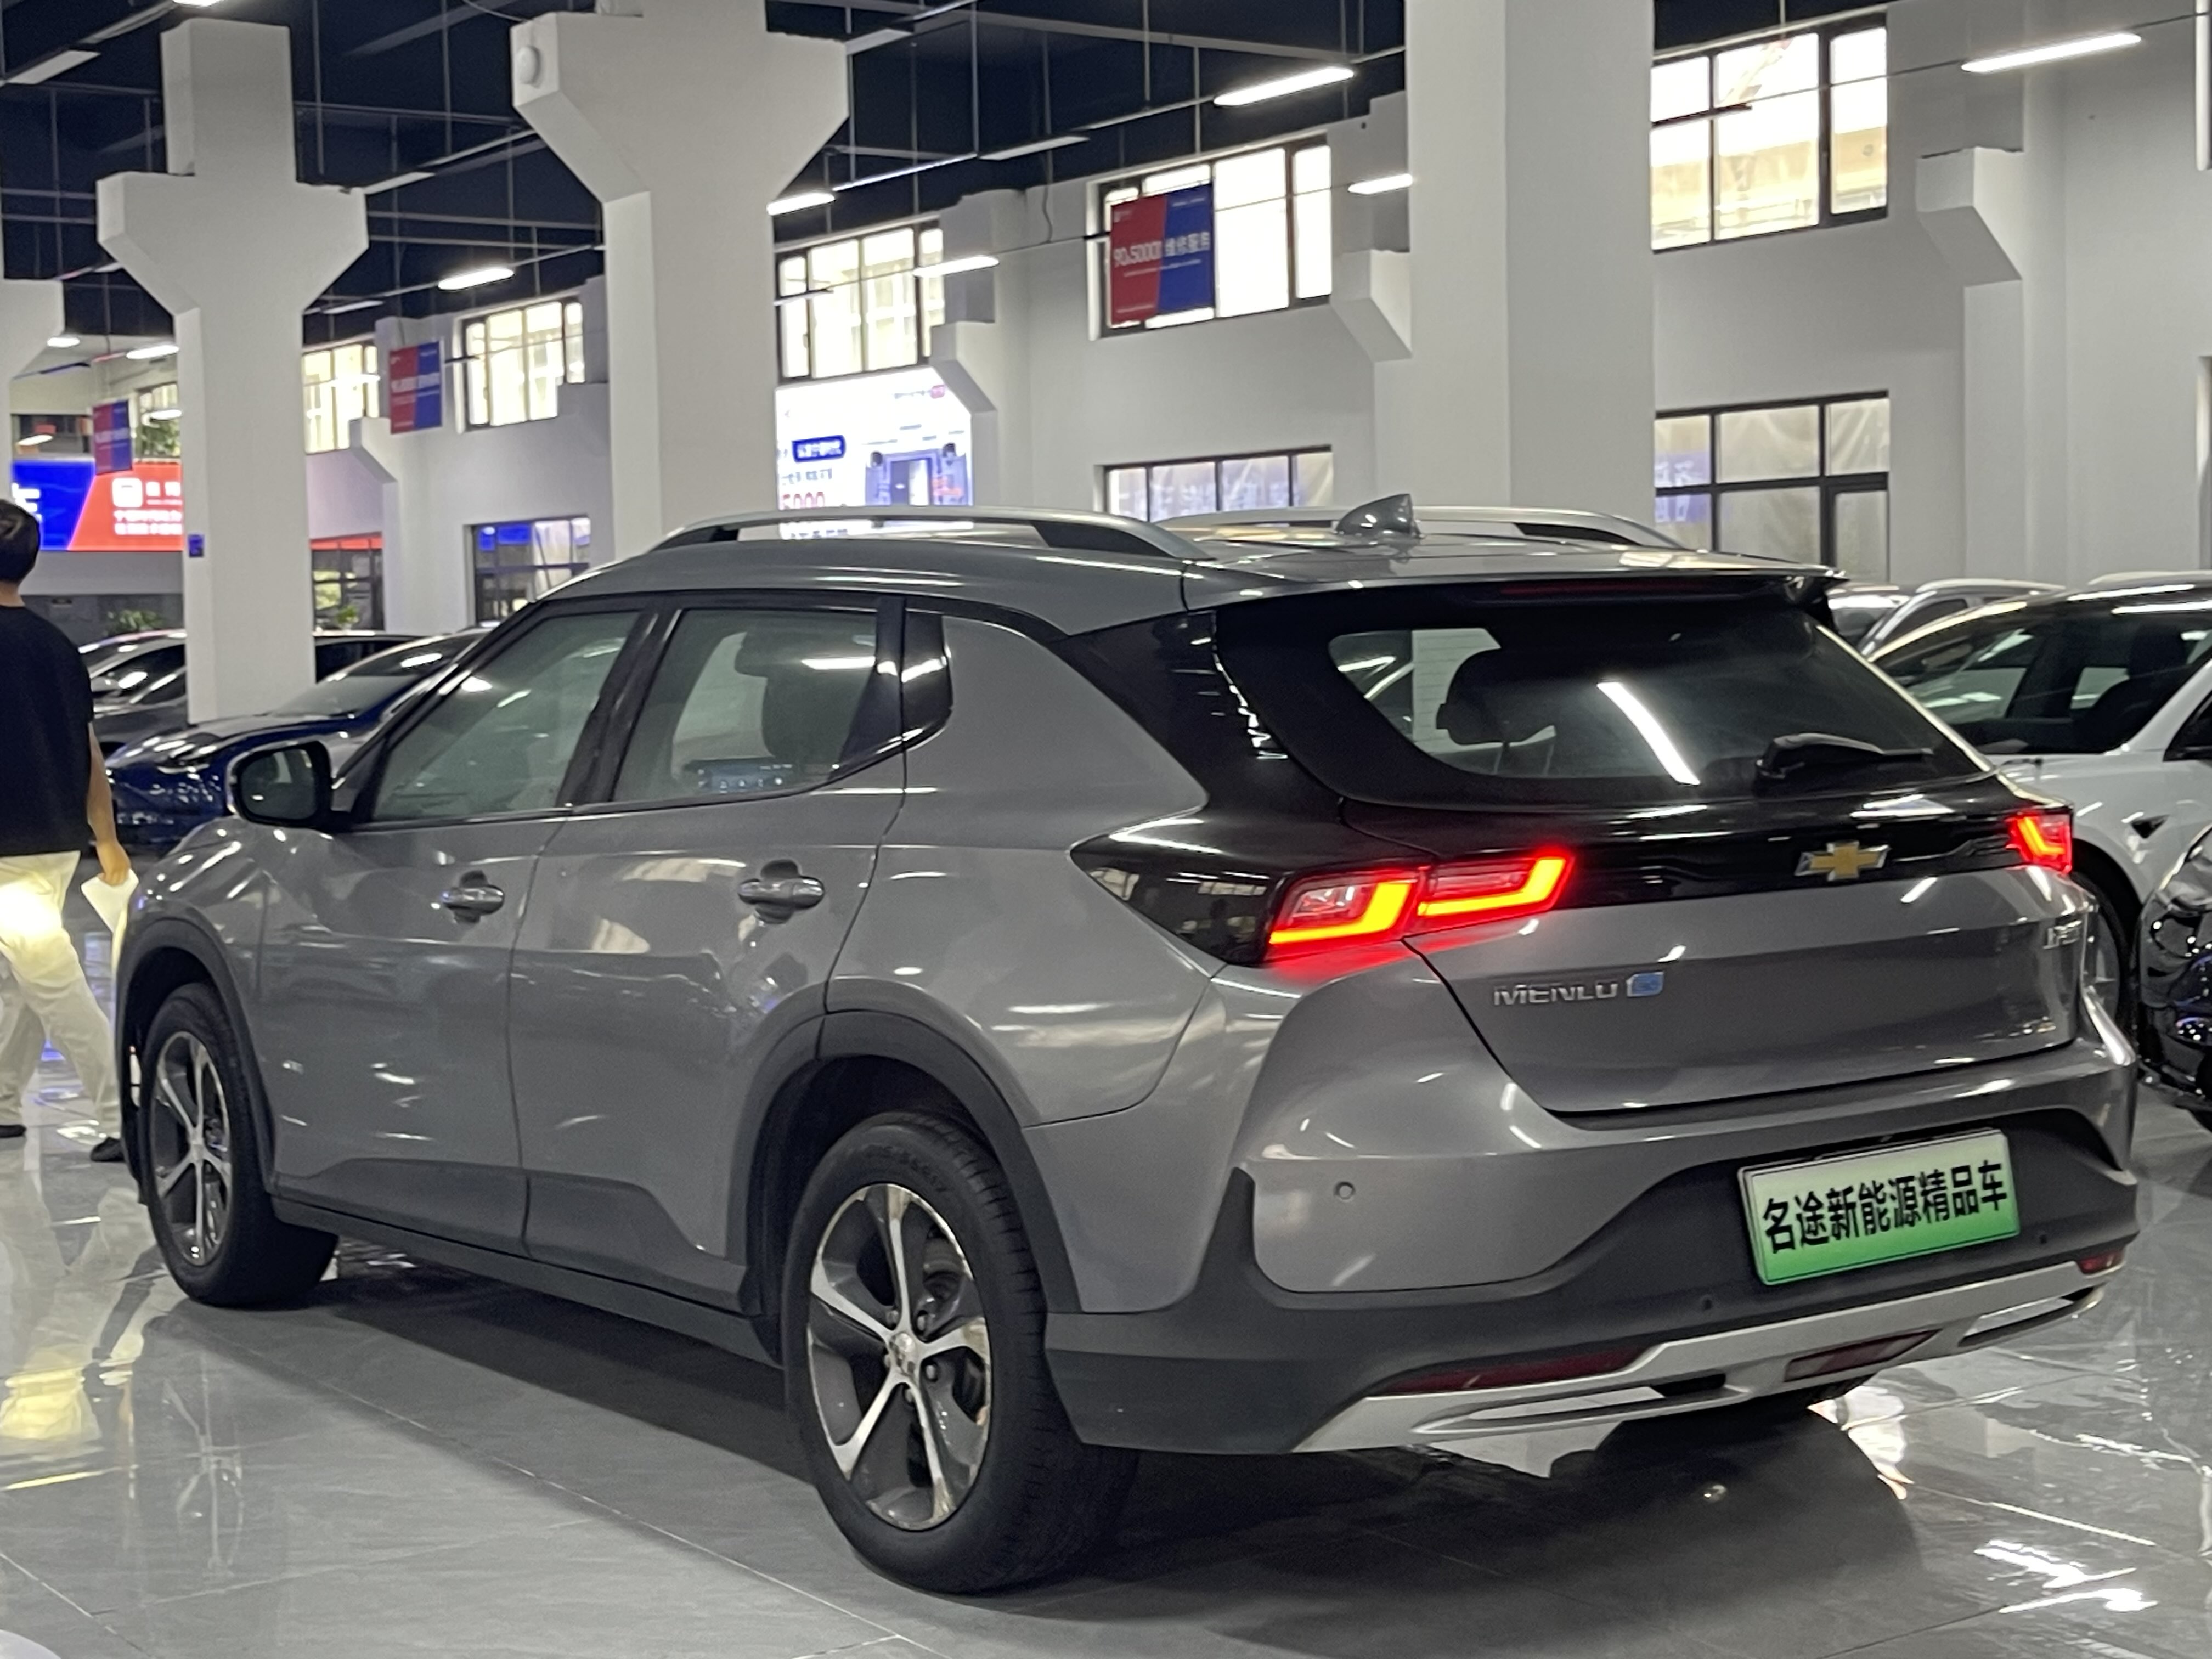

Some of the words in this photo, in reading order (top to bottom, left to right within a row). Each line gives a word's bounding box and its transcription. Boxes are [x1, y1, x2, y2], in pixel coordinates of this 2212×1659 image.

[1762, 1159, 2008, 1254] 名途新能源精品车
